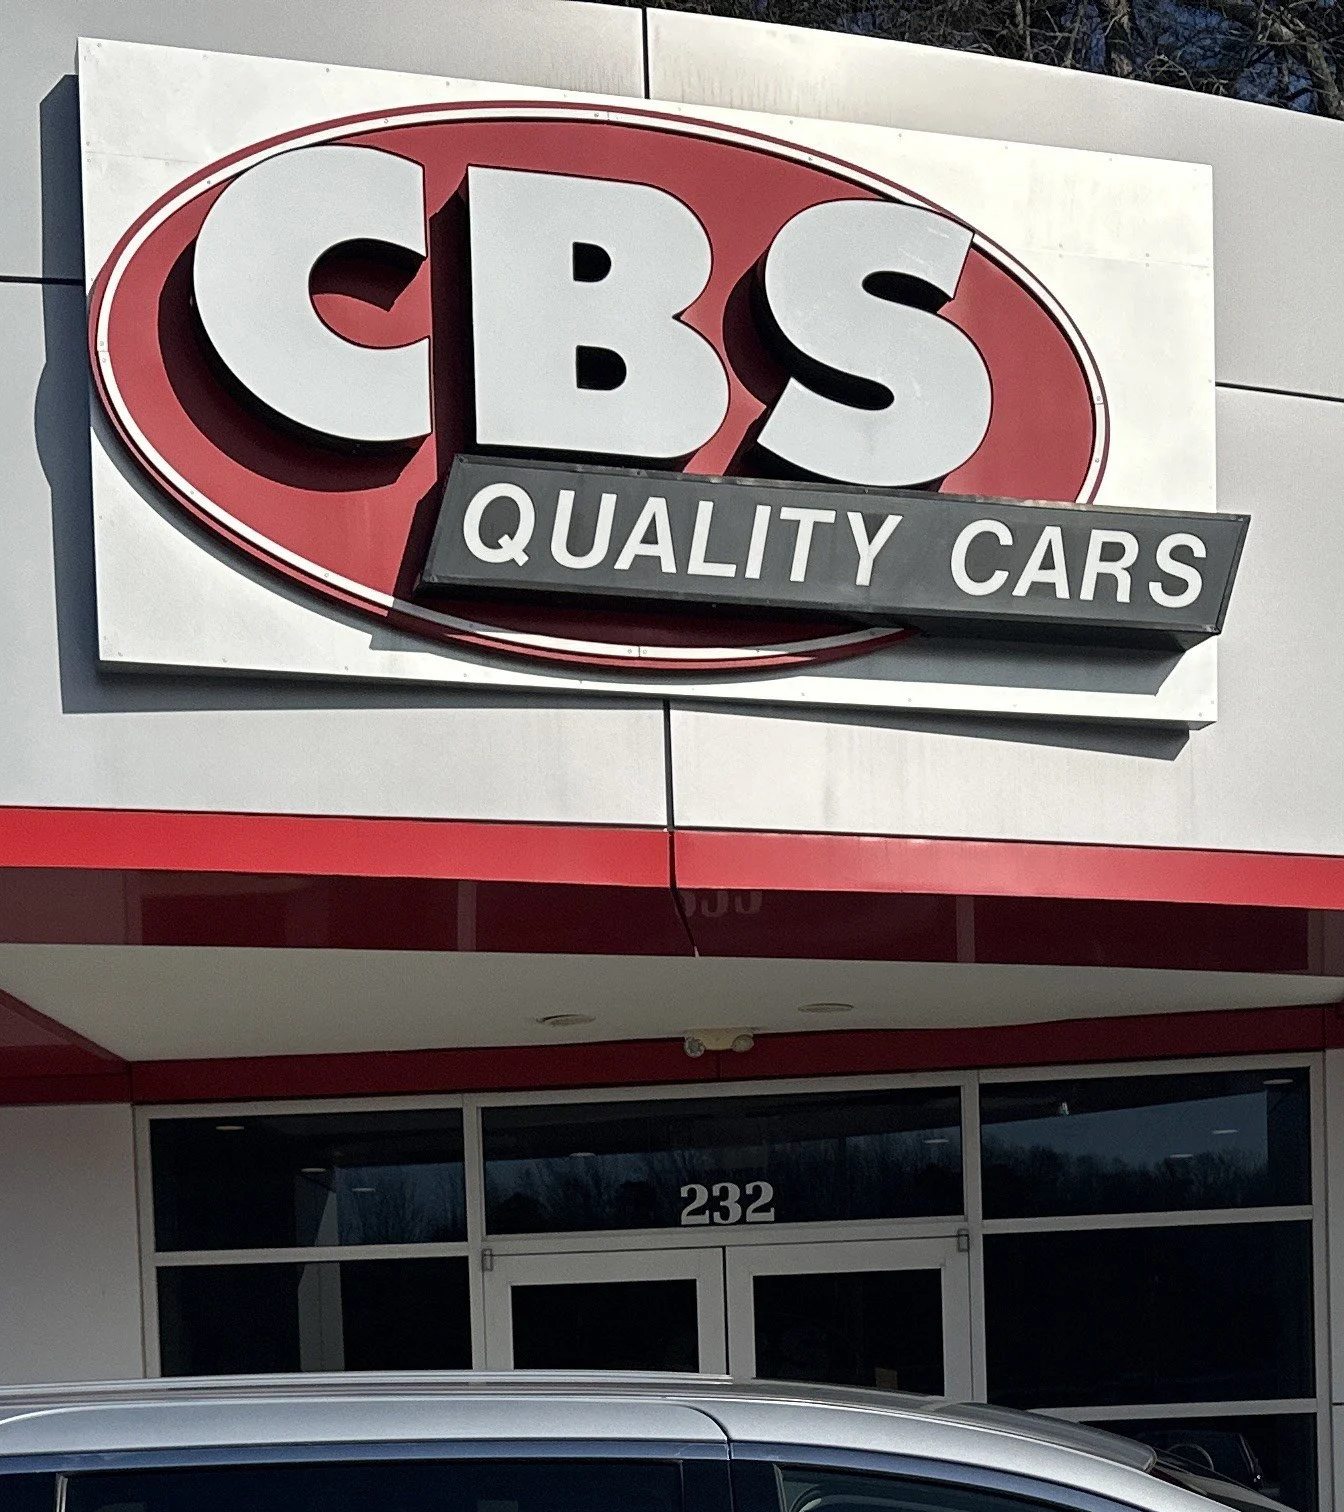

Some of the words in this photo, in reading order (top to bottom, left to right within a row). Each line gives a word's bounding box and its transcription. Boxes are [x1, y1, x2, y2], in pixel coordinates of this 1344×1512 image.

[192, 144, 993, 488] CBS
[462, 482, 903, 587] QUALITY
[950, 519, 1207, 609] CARS
[679, 1180, 775, 1226] 232
